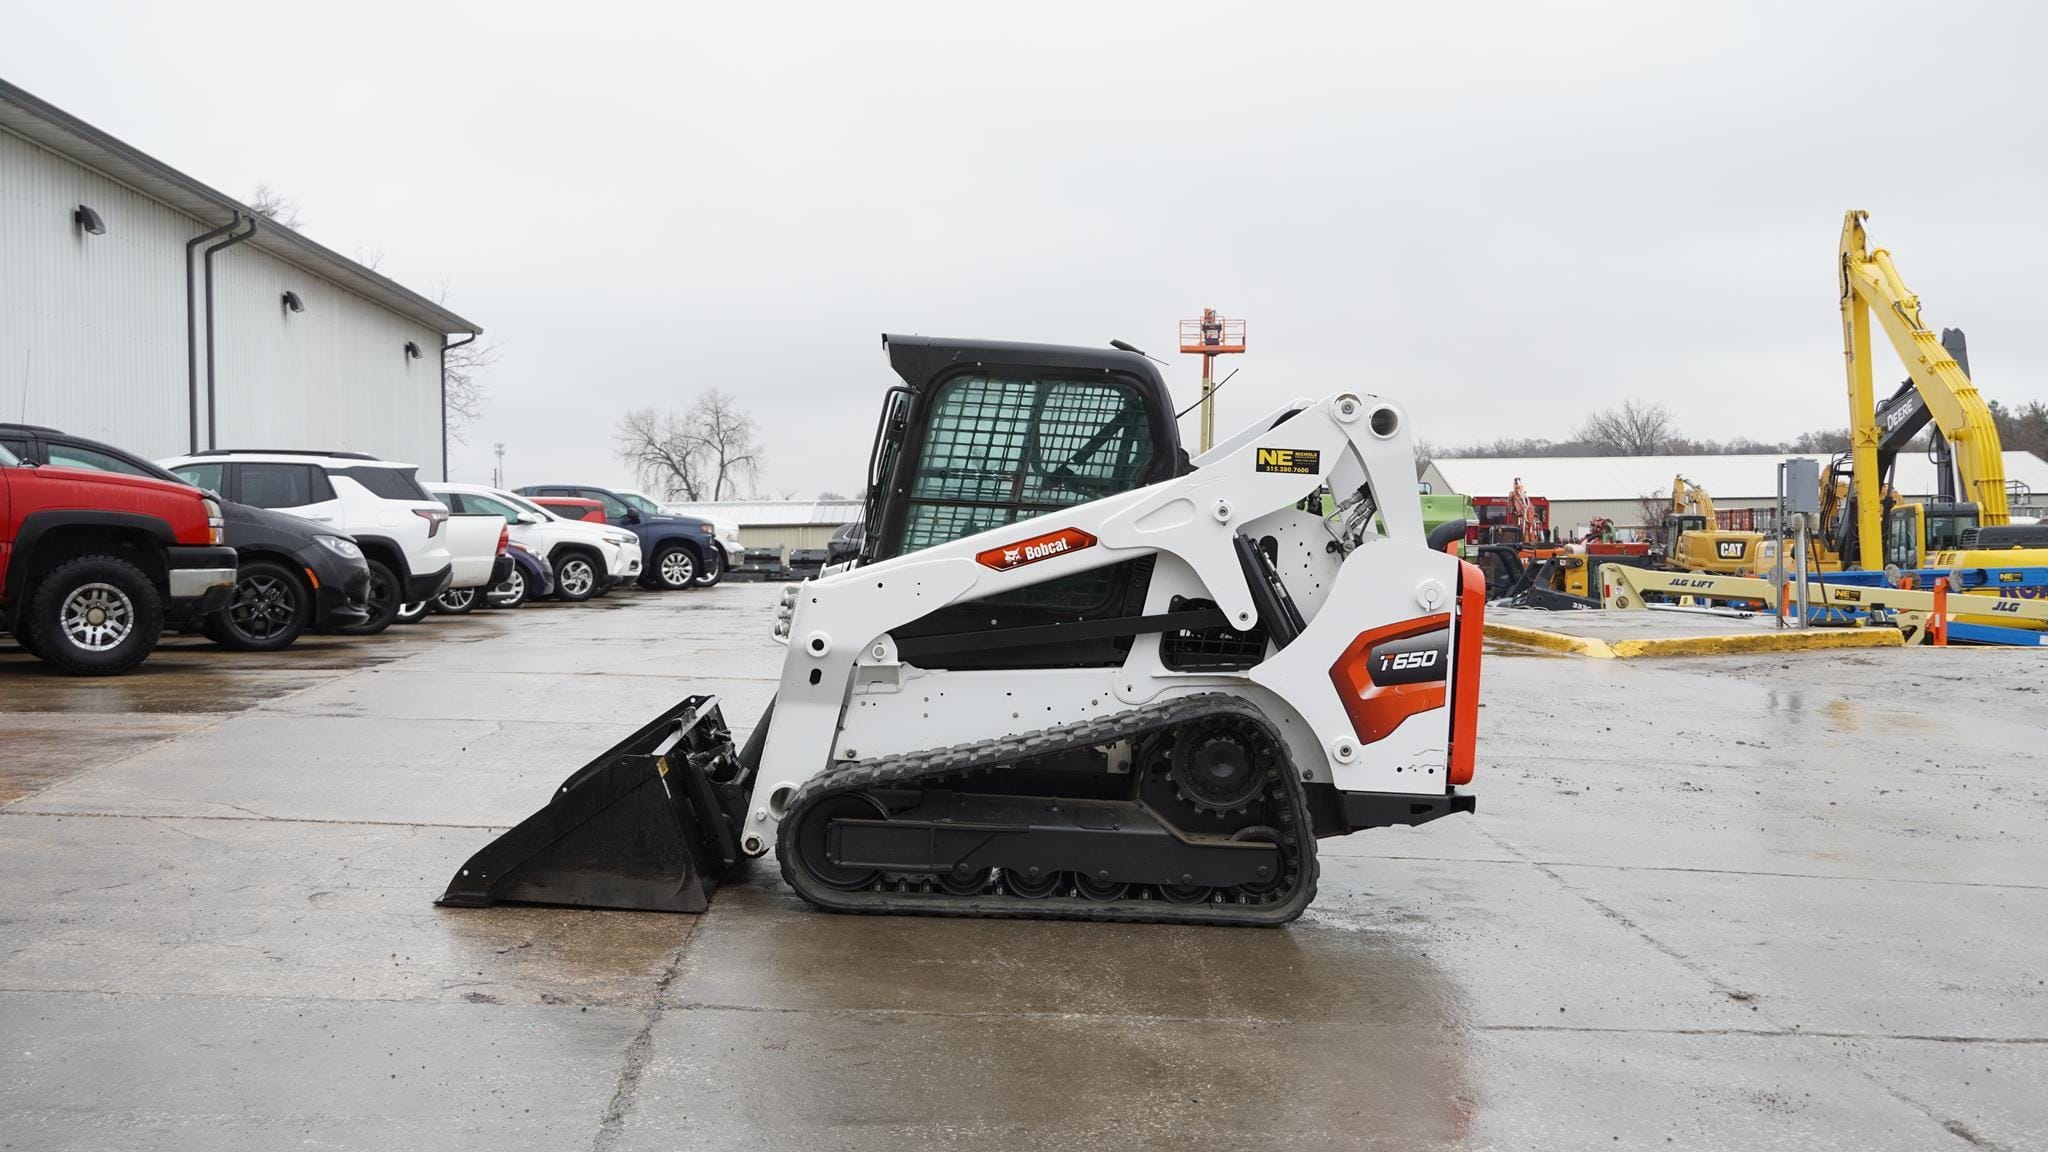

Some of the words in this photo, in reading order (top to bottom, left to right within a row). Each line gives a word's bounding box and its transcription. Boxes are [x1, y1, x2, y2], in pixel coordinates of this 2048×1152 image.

[1887, 399, 1913, 431] DEERE
[1258, 449, 1293, 466] NE
[1025, 538, 1068, 560] Bobcat
[1720, 543, 1743, 557] CAT
[1669, 578, 1689, 587] JLG
[1690, 580, 1714, 588] LIFT
[1836, 590, 1850, 598] NE
[1992, 601, 2020, 612] JLG
[1380, 650, 1438, 671] T650
